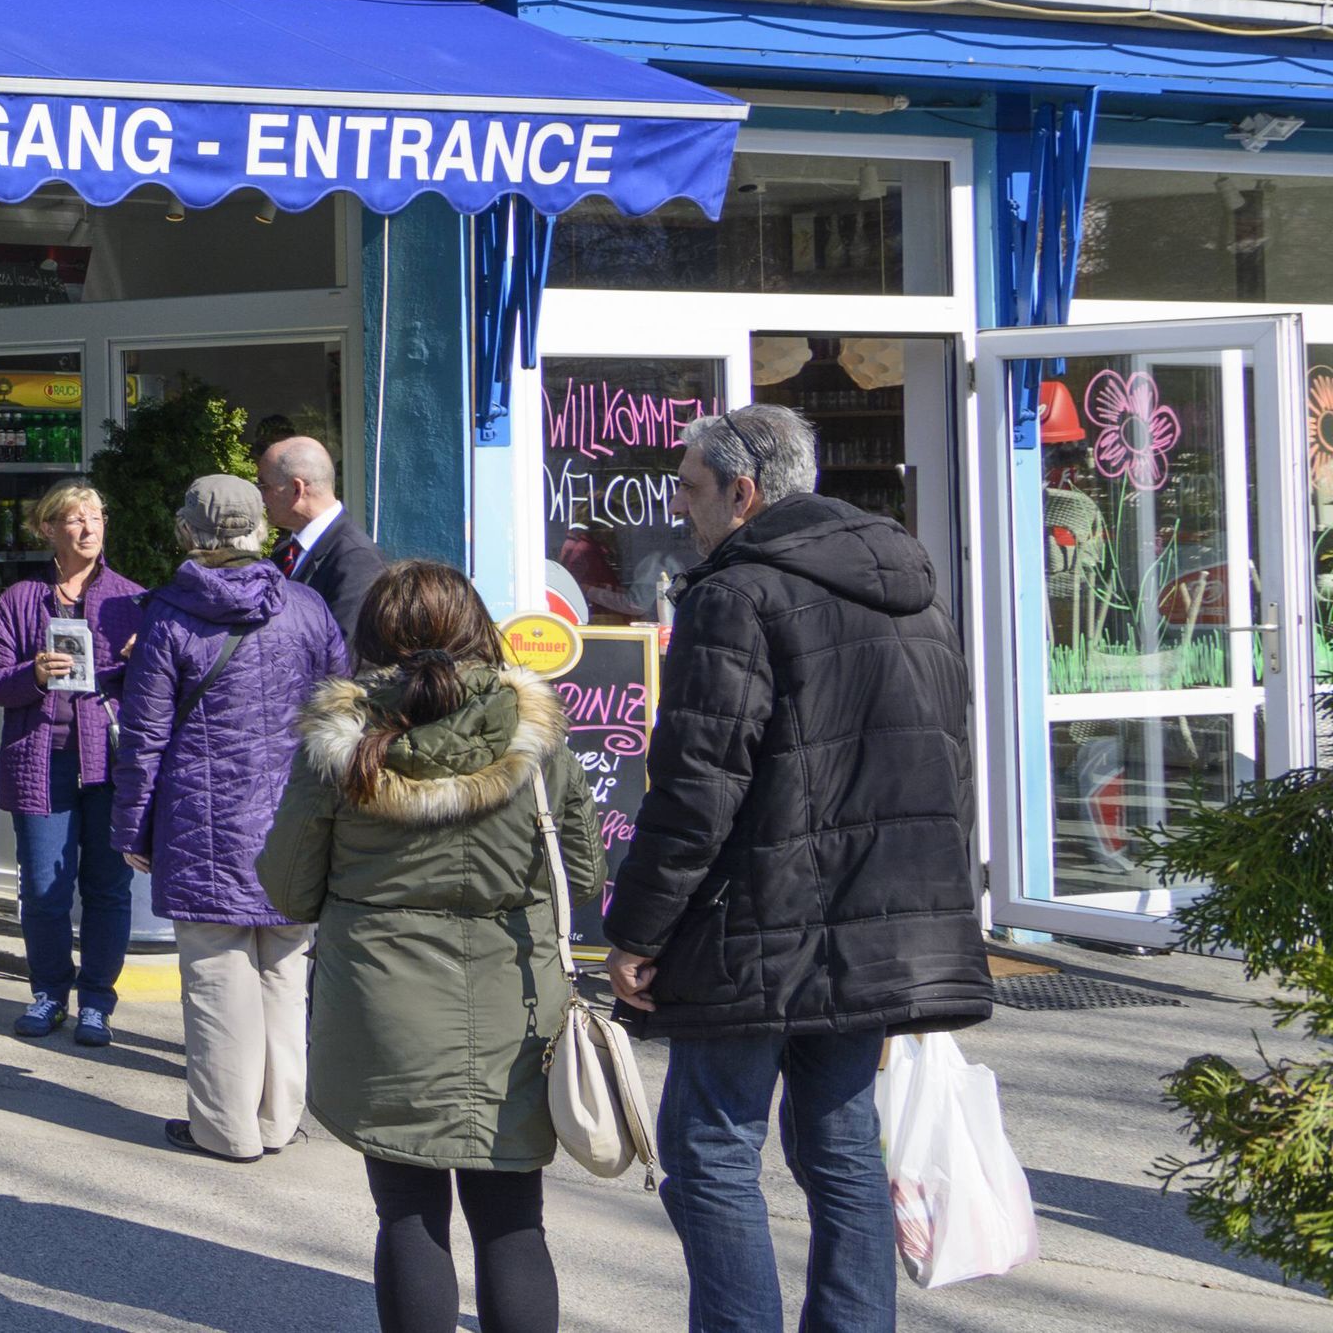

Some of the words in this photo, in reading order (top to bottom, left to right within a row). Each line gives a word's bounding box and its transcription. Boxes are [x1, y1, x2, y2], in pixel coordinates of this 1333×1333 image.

[197, 139, 220, 157] -
[245, 113, 622, 185] ENTRANCE
[53, 384, 79, 396] RAUCH
[510, 633, 568, 653] Murauer
